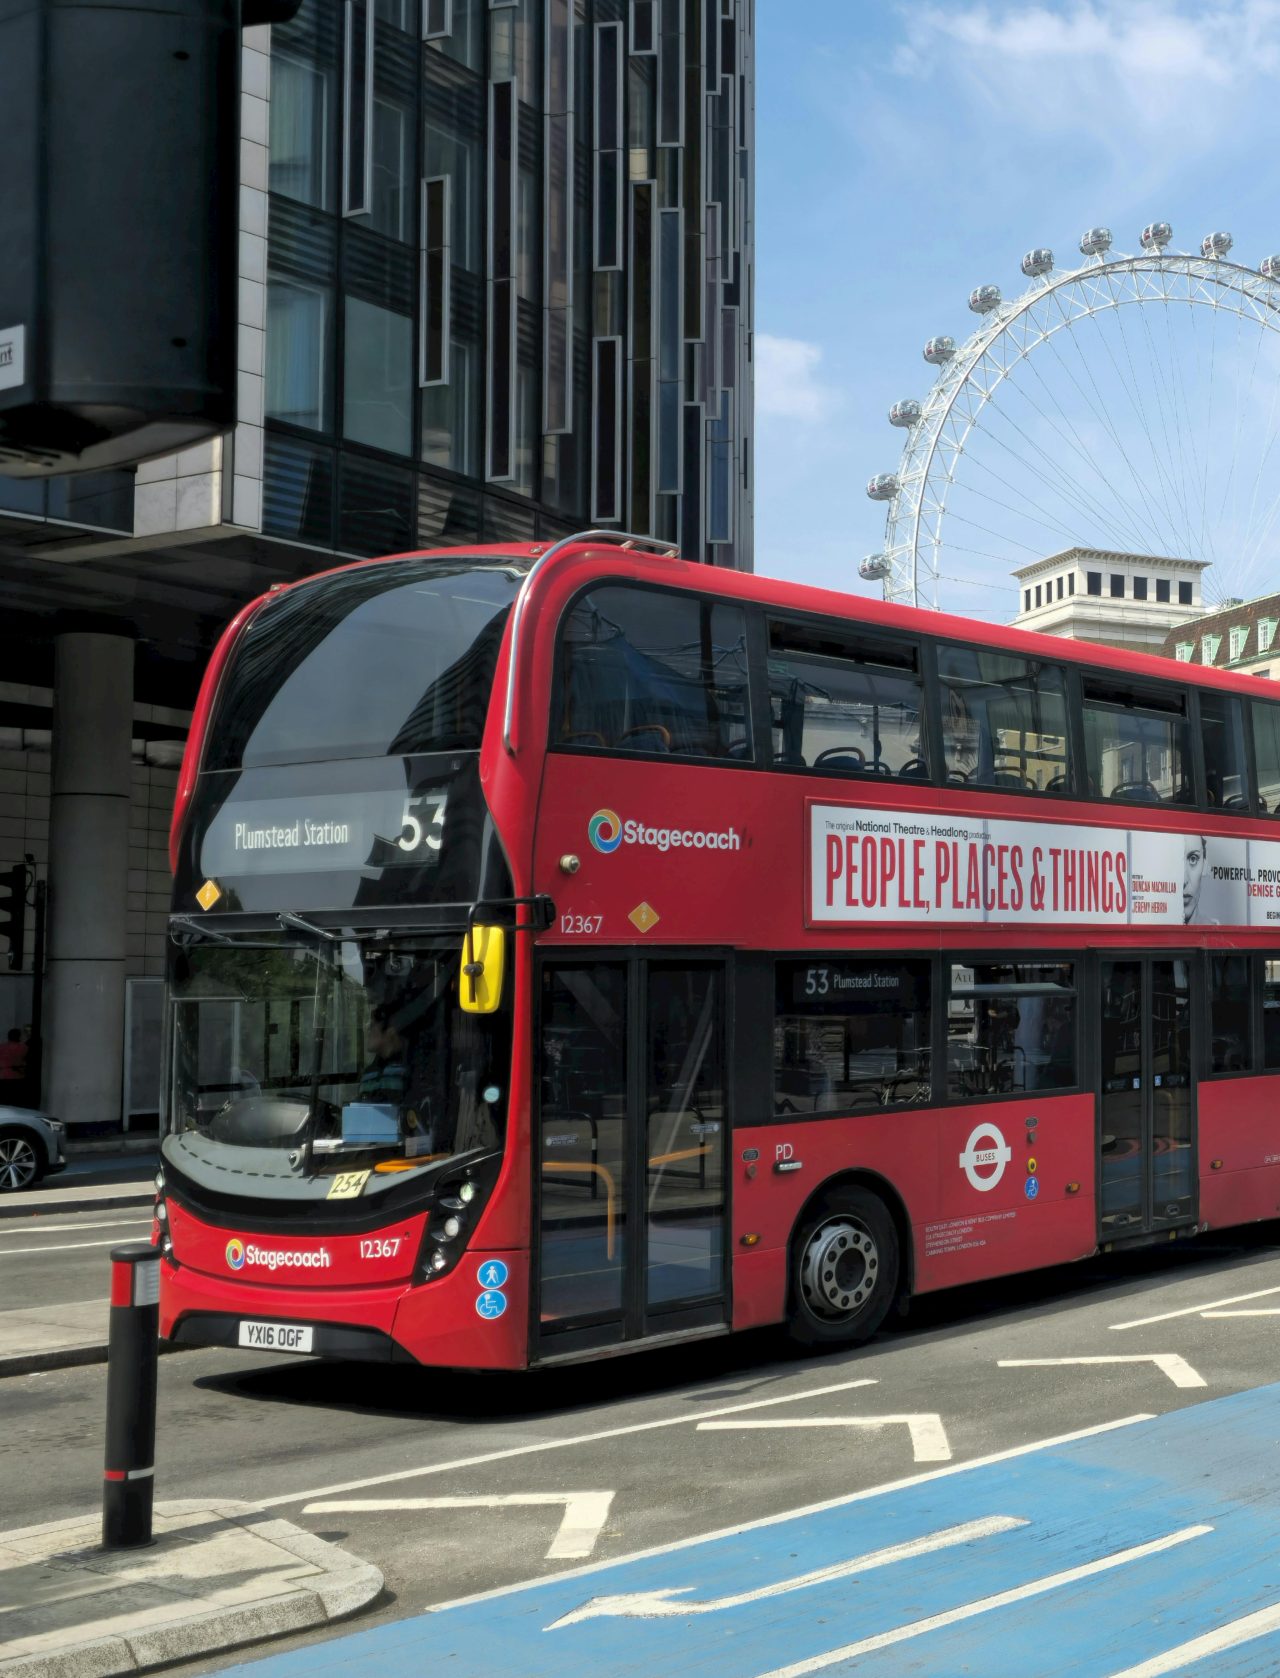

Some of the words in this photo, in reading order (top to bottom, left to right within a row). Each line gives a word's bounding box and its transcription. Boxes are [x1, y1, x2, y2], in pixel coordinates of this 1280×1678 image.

[398, 795, 447, 851] 53
[825, 820, 834, 830] The
[855, 820, 891, 833] National
[893, 823, 925, 836] Theatre
[931, 826, 968, 840] Headlong
[235, 820, 299, 850] Plumstead
[304, 818, 348, 846] Station
[623, 820, 740, 852] Stagecoach
[825, 833, 930, 914] PEOPLE,
[936, 840, 1023, 911] PLACES
[1030, 846, 1045, 912] &
[1049, 848, 1127, 914] THINGS
[1247, 884, 1274, 897] DENISE
[561, 915, 603, 933] 12367
[805, 969, 829, 995] 53
[833, 974, 872, 989] Plumstead
[873, 974, 899, 988] Station
[776, 1143, 793, 1160] PD
[975, 1152, 996, 1163] BUSES
[332, 1174, 365, 1194] 254
[246, 1245, 330, 1270] Stagecoach
[360, 1238, 401, 1258] 12367
[248, 1325, 274, 1345] YX16
